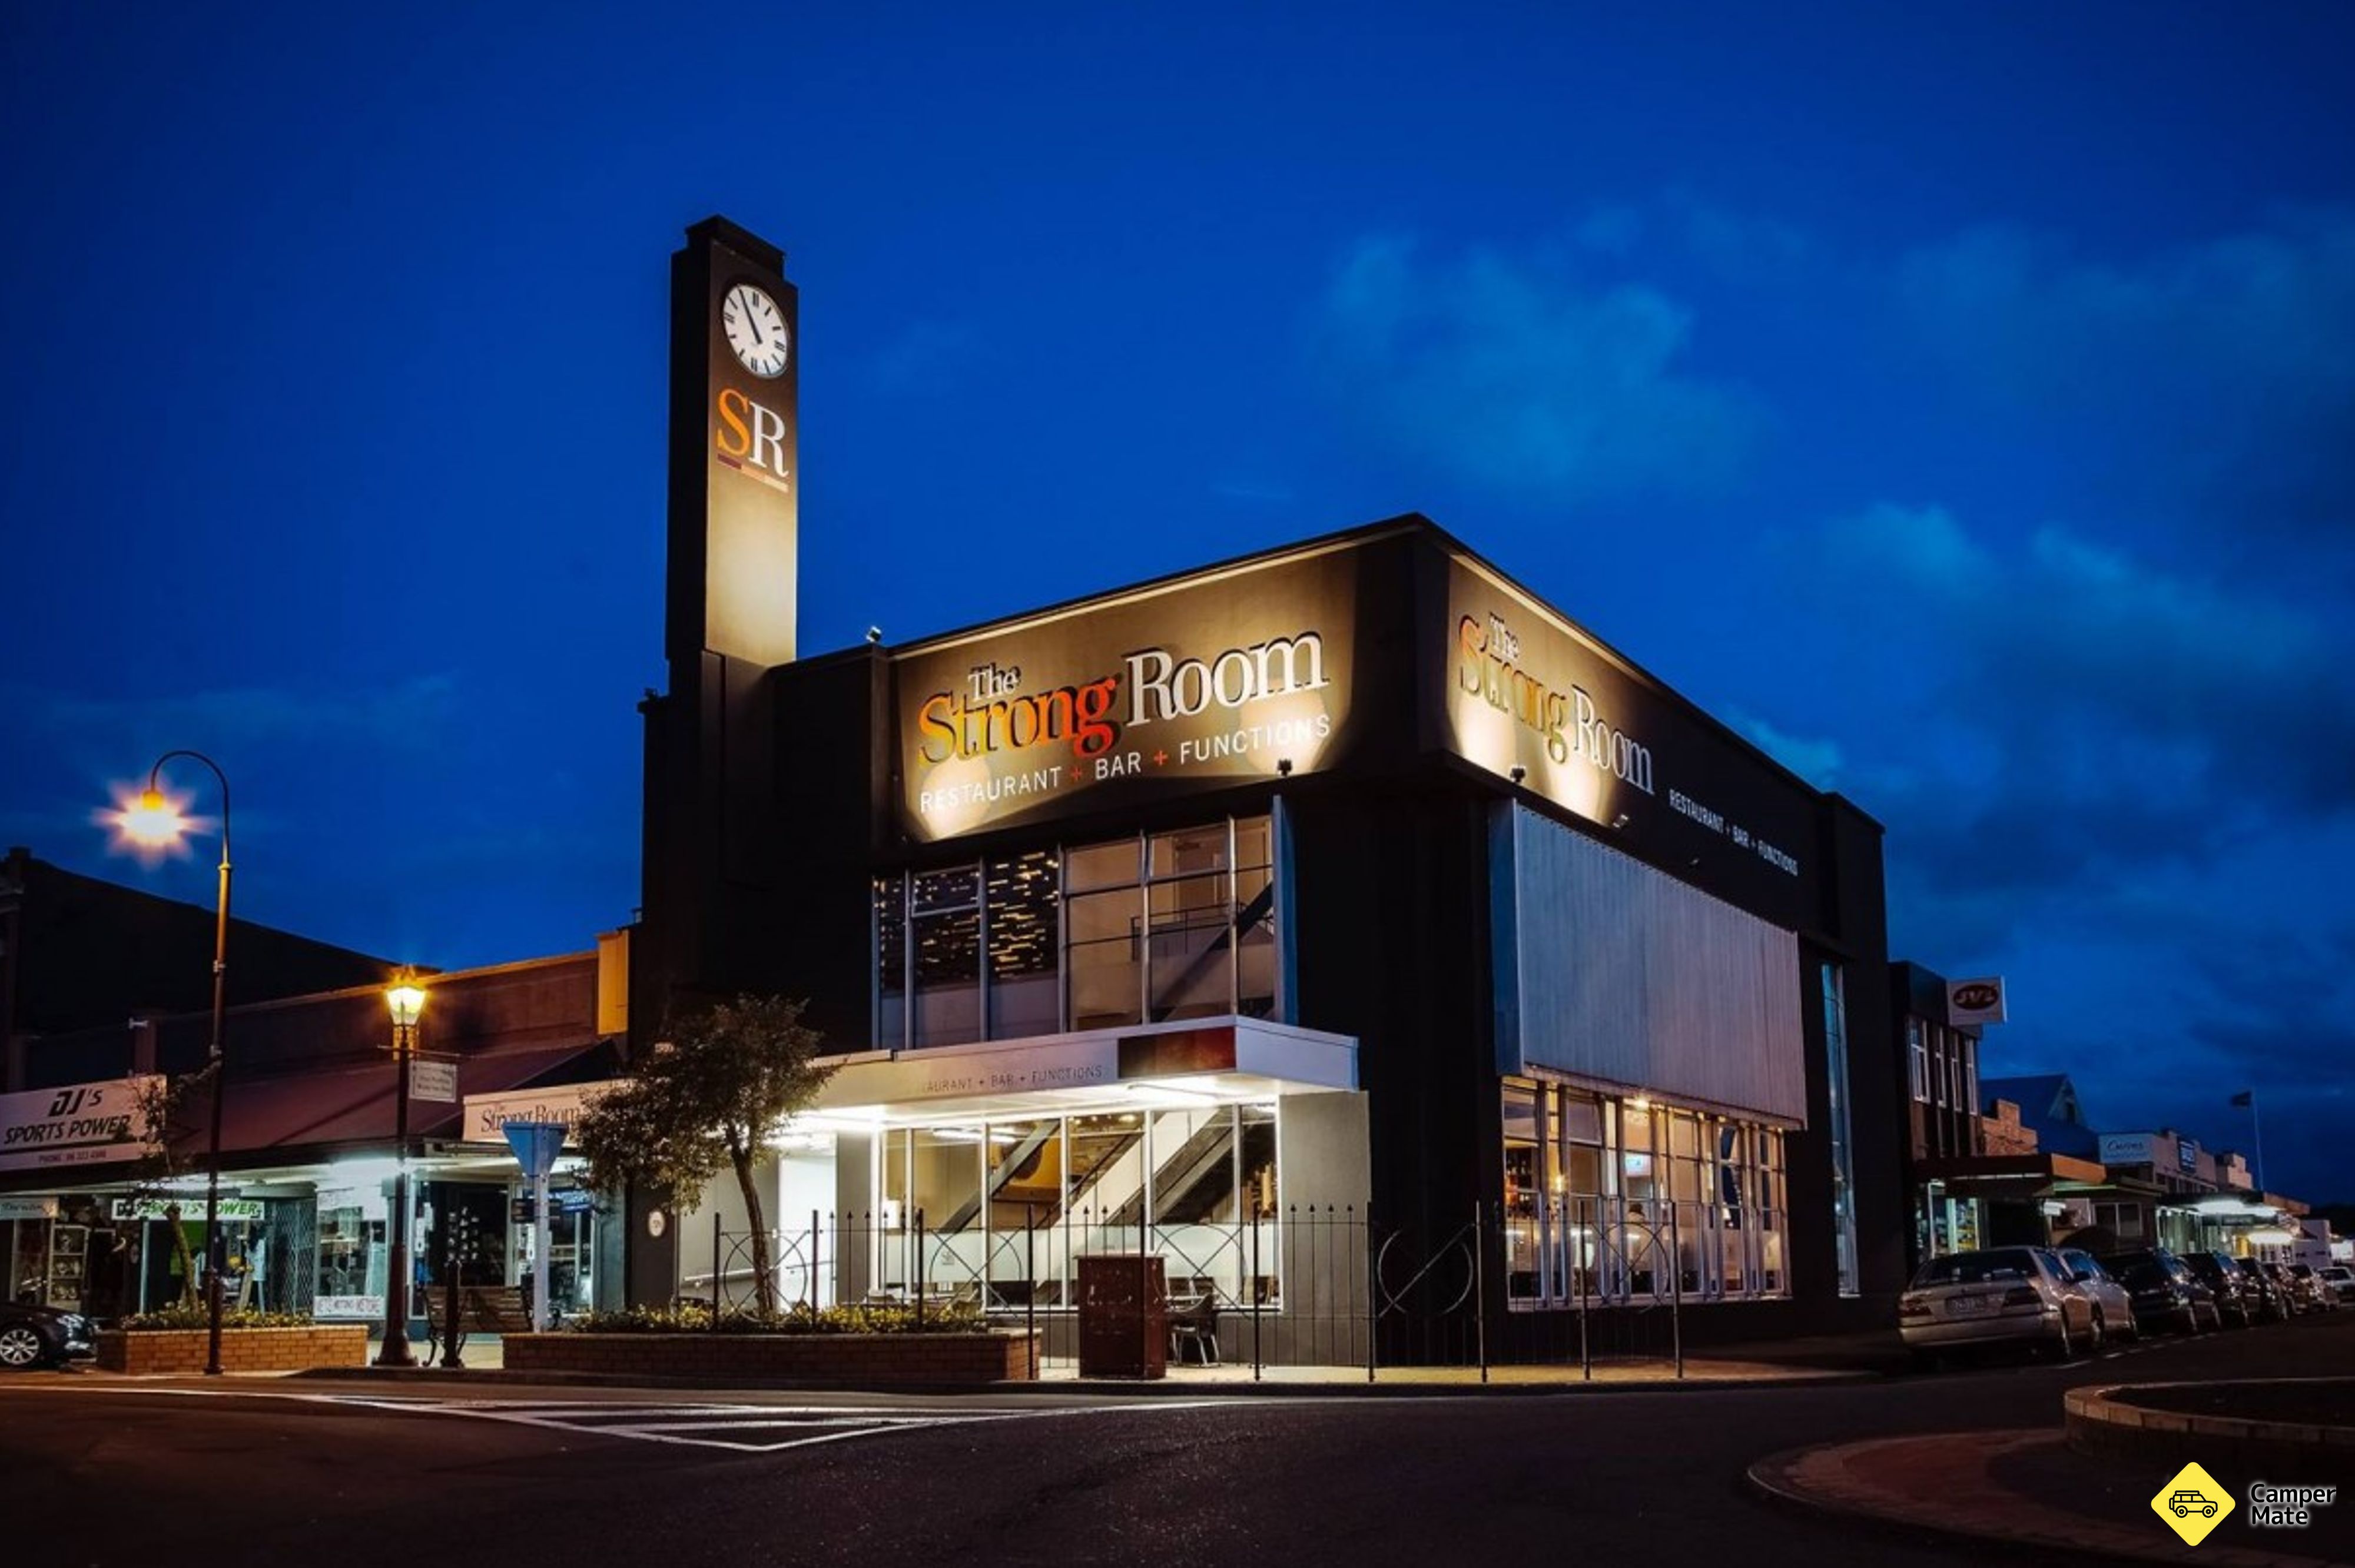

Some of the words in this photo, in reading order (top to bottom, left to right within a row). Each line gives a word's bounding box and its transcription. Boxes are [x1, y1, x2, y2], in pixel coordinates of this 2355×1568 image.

[717, 388, 788, 477] SR
[1490, 612, 1519, 659] The
[917, 675, 1119, 768] Strong
[1123, 631, 1330, 727] Room
[968, 662, 1021, 702] The
[921, 767, 1061, 813] RESTAURANT
[1095, 751, 1142, 780] BAR
[1180, 714, 1330, 765] FUNCTIONS
[1573, 685, 1654, 795] Room
[1670, 788, 1723, 834] RESTAURANT
[1732, 825, 1749, 848] BAR
[924, 1078, 973, 1094] AURANT
[991, 1075, 1013, 1088] BAR
[1031, 1065, 1103, 1082] FUNCTIONS
[4, 1121, 65, 1144] SPORTS
[64, 1114, 131, 1138] POWER
[205, 1201, 257, 1215] OWER
